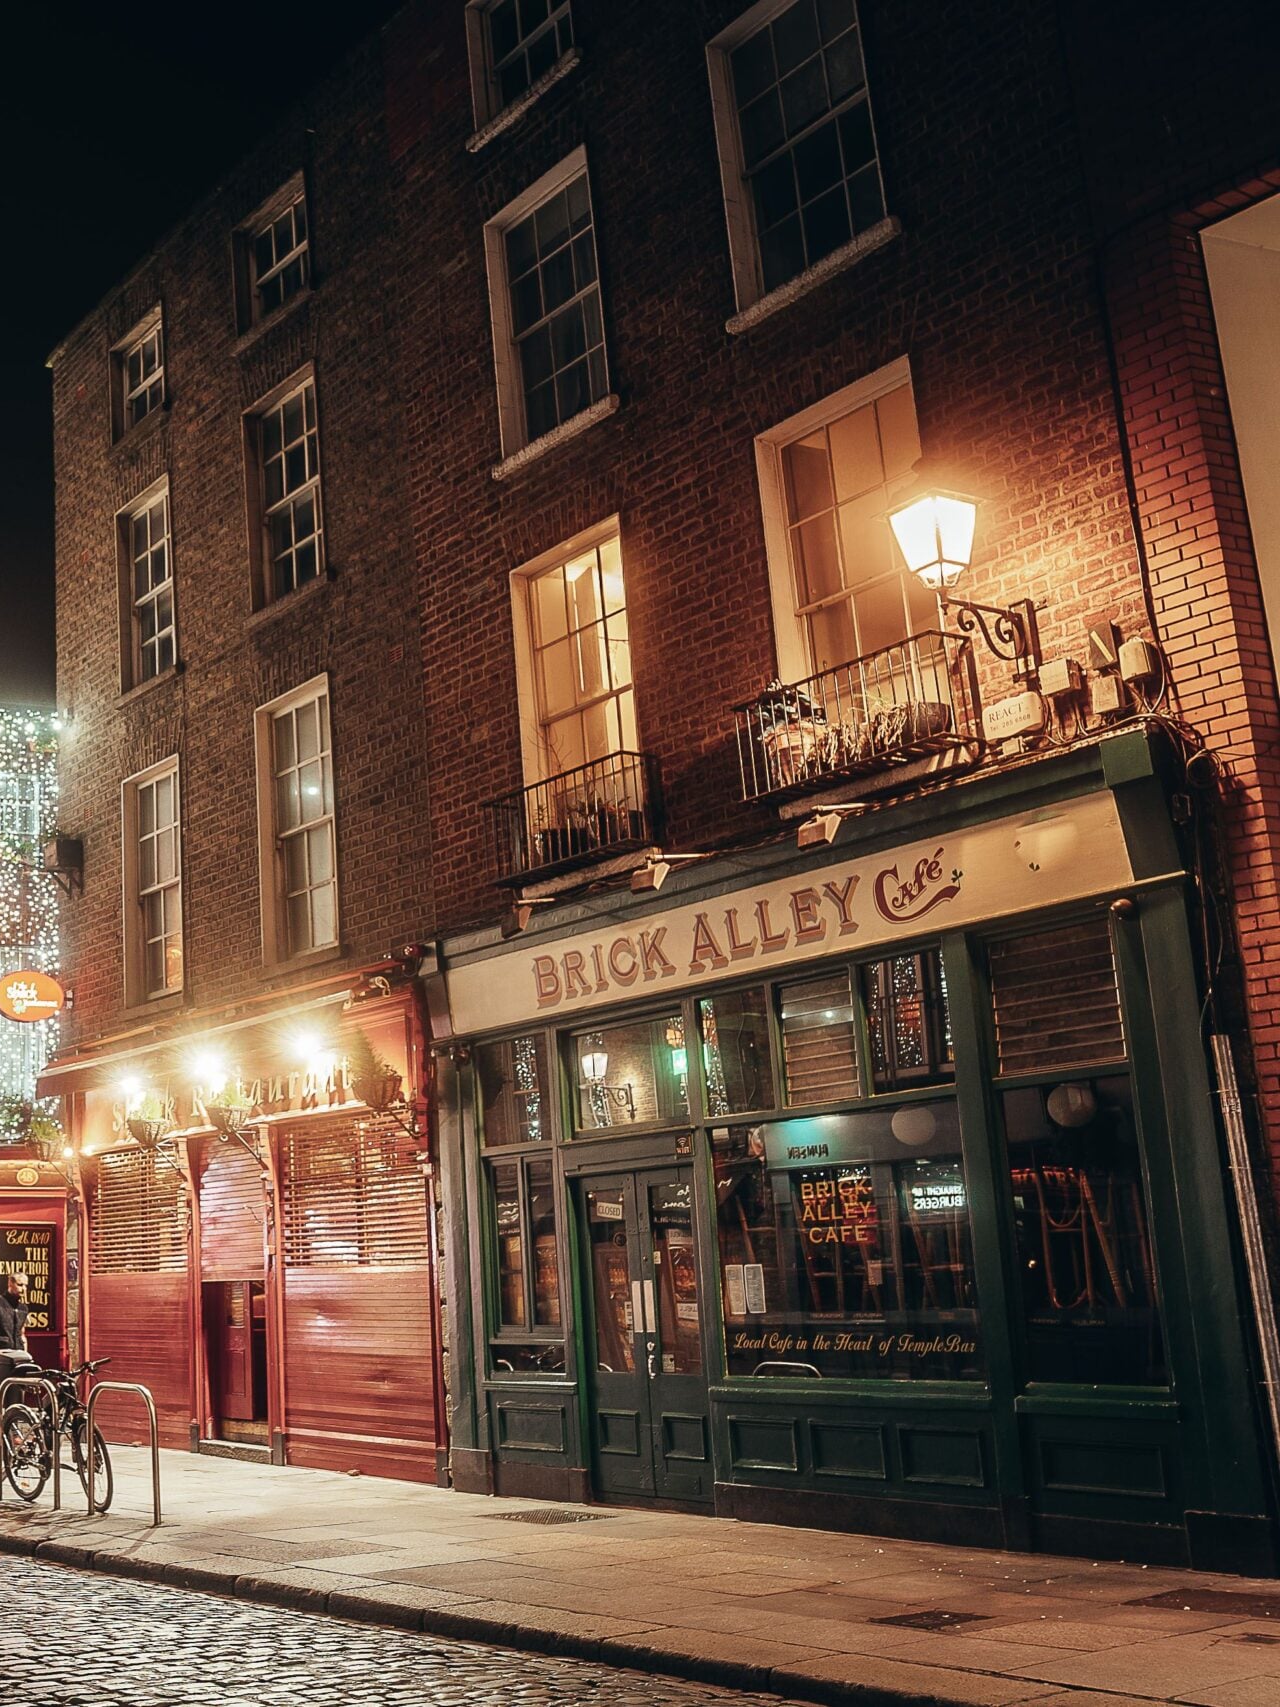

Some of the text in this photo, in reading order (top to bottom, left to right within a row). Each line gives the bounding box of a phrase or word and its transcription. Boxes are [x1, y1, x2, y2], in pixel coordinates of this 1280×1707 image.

[988, 702, 1024, 723] REACT
[532, 926, 678, 1010] BRICK
[689, 874, 861, 976] ALLEY
[800, 1178, 869, 1199] BRICK
[598, 1205, 621, 1217] CLOSED
[802, 1201, 872, 1221] ALLEY
[31, 1231, 50, 1245] 1840
[809, 1219, 869, 1244] CAFÉ
[25, 1247, 49, 1261] THE
[34, 1275, 49, 1290] OF
[733, 1332, 767, 1350] Local
[769, 1332, 793, 1354] Cafe
[796, 1336, 808, 1350] in
[813, 1333, 831, 1351] the
[834, 1333, 873, 1351] Heart
[879, 1335, 896, 1357] of
